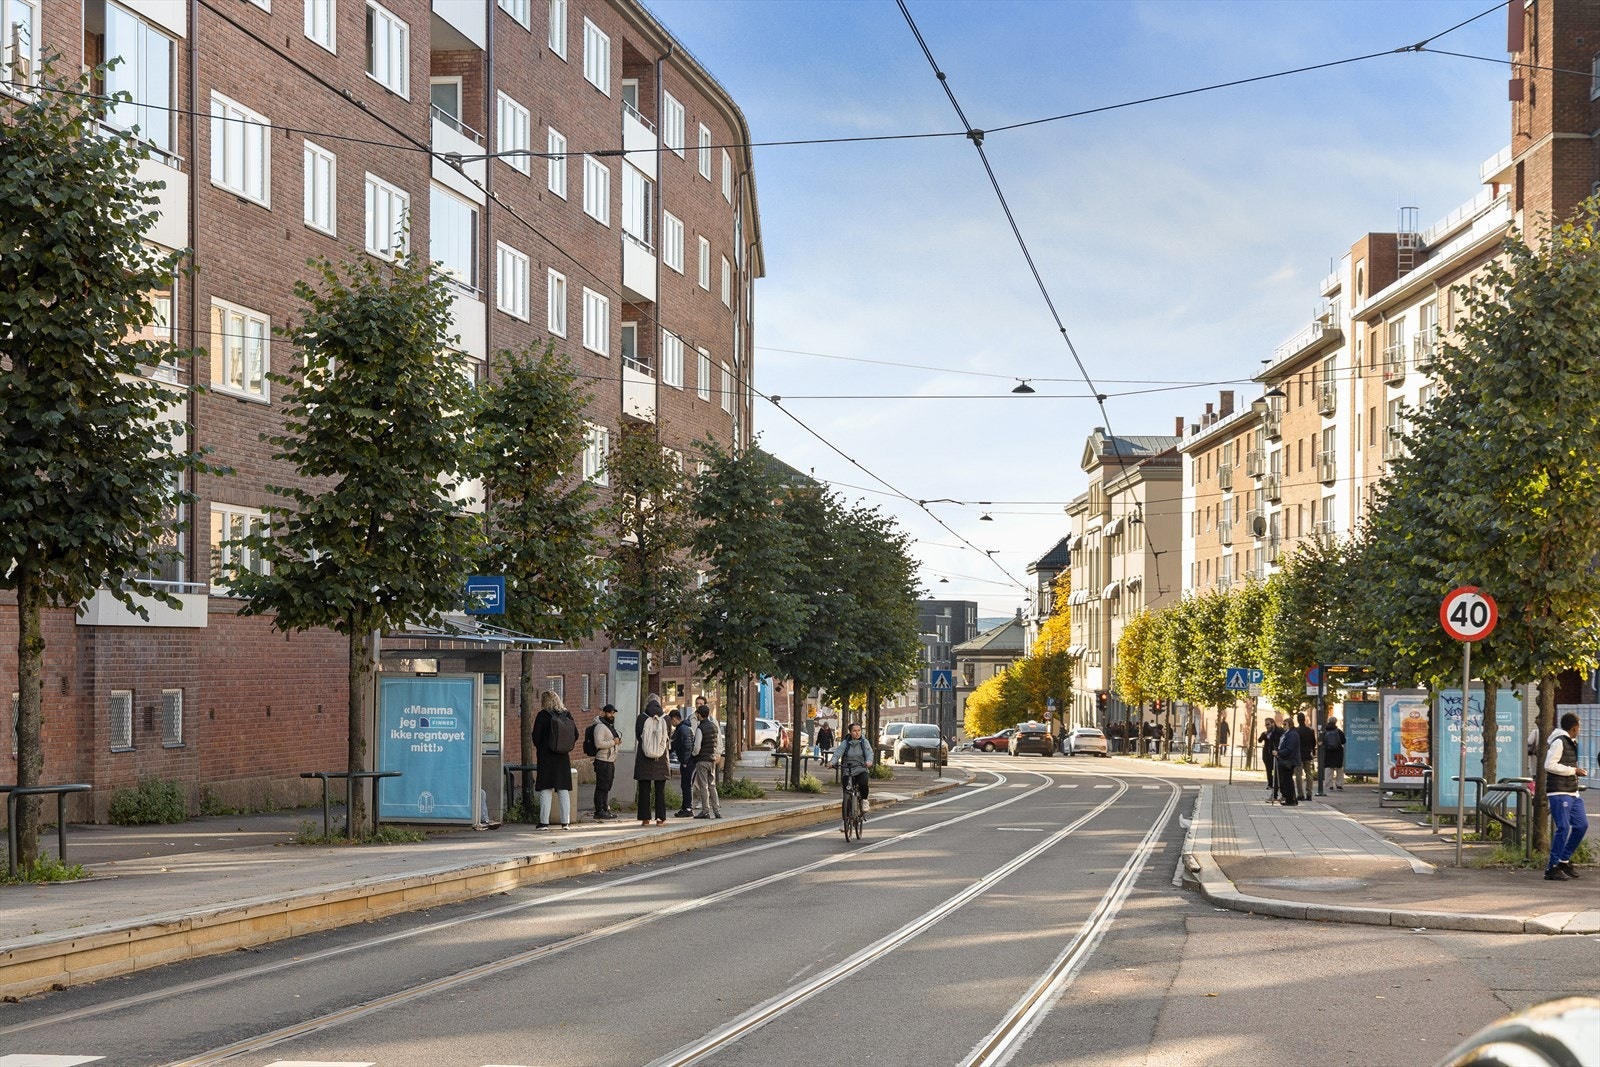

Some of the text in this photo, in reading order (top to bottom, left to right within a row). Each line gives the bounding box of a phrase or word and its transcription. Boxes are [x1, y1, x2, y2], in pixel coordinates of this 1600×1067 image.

[1450, 601, 1488, 628] 40
[1252, 671, 1261, 682] P
[404, 705, 453, 715] «Mamma
[399, 717, 417, 729] jeg
[390, 729, 465, 742] ikke regntøyet
[411, 742, 444, 752] mitt!»
